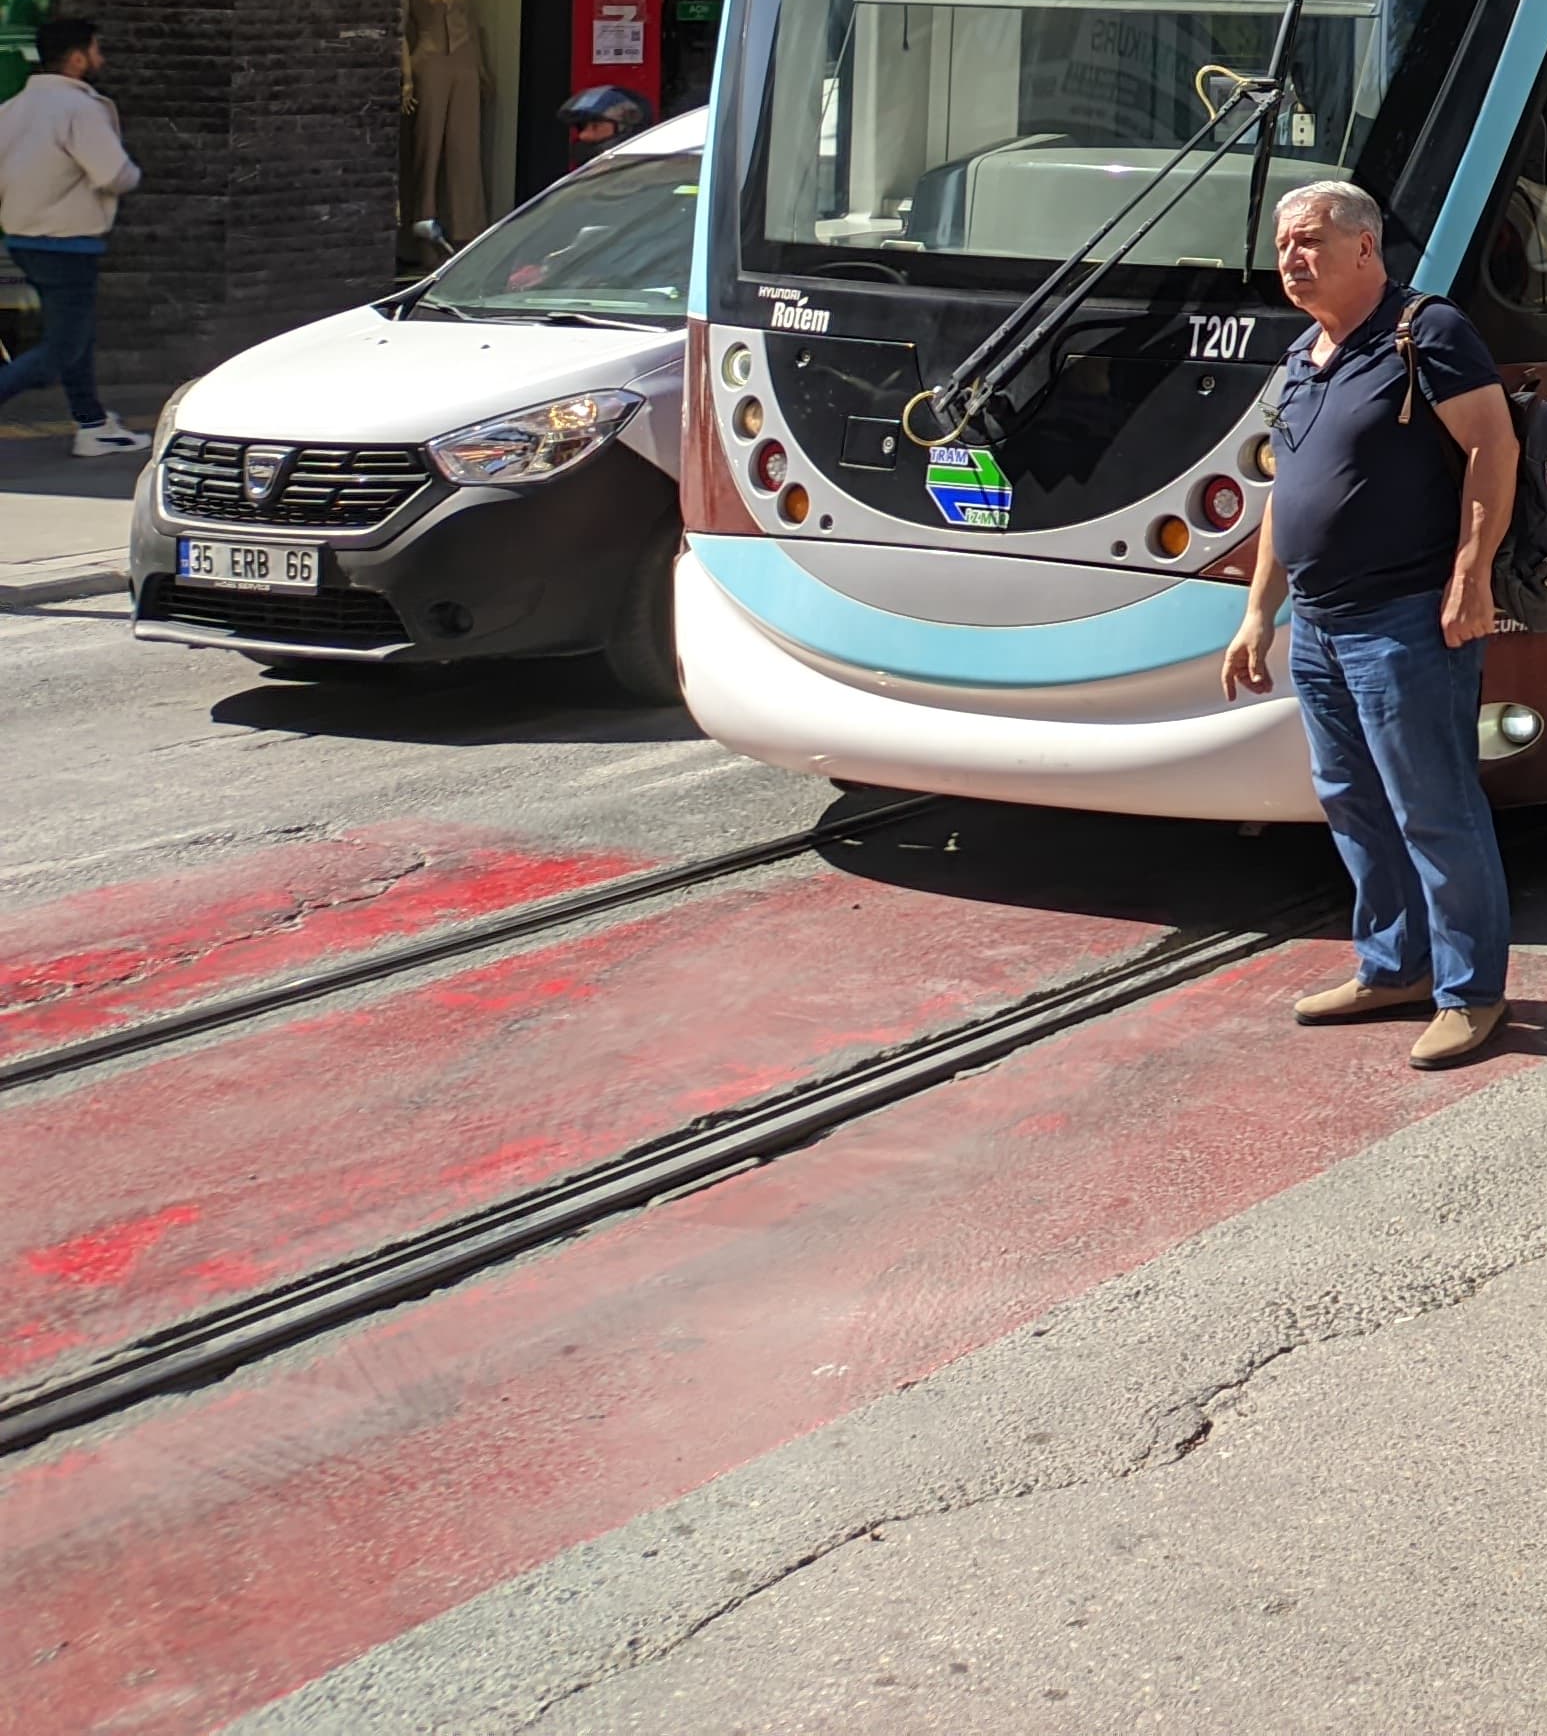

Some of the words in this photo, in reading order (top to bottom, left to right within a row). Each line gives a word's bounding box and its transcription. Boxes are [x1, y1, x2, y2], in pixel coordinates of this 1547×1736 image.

[758, 286, 801, 299] HYUNDAI
[771, 296, 831, 333] Rotem
[1189, 315, 1256, 359] T207
[930, 446, 969, 464] TRAM
[965, 507, 1009, 530] İZMİR
[191, 543, 213, 574] 35
[230, 547, 270, 578] ERB
[286, 550, 313, 581] 66
